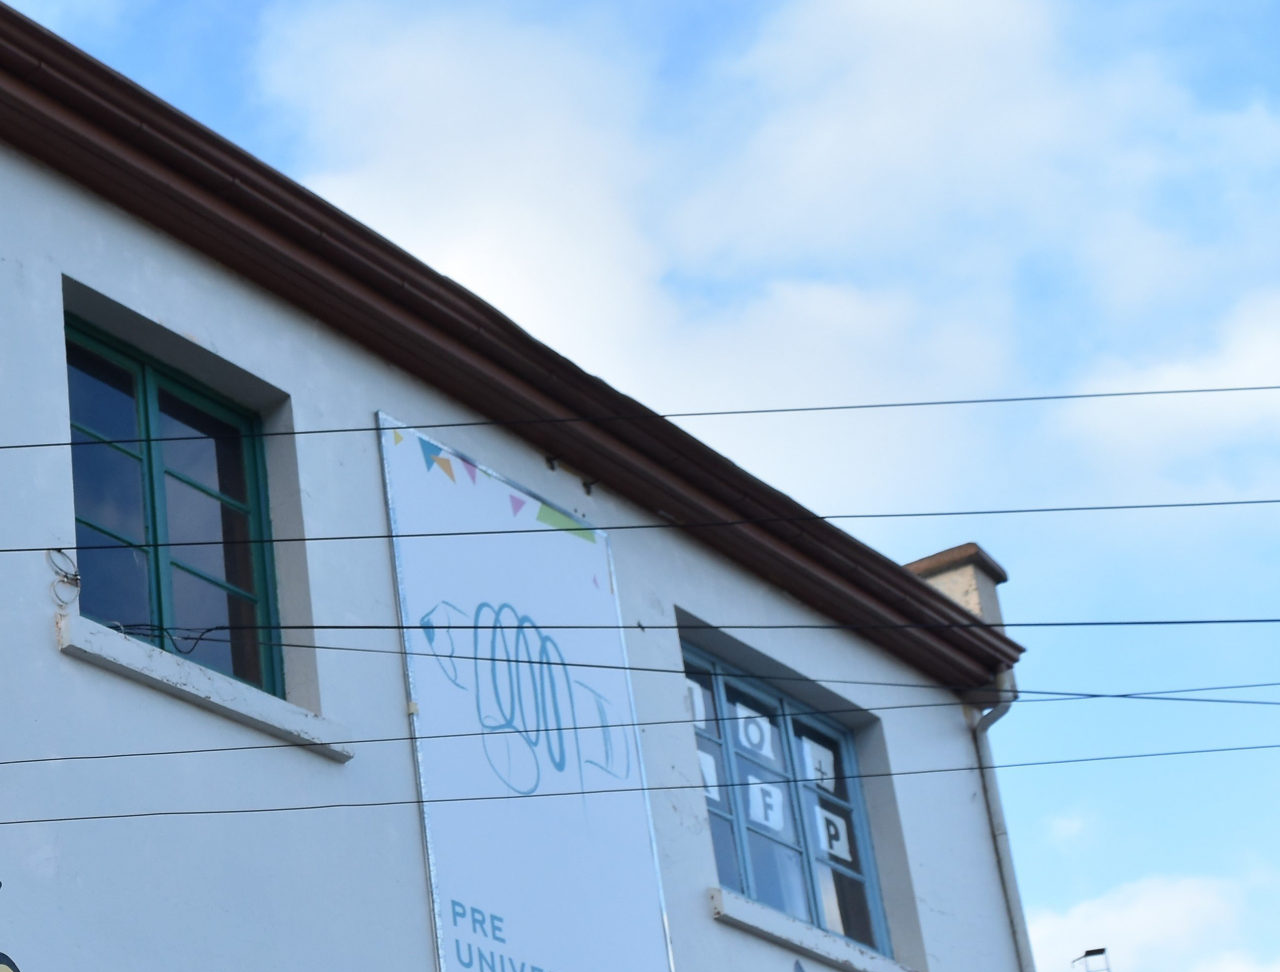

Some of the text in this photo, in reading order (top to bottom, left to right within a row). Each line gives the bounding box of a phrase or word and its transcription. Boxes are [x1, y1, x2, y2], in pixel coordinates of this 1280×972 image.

[761, 786, 775, 821] F
[824, 816, 841, 851] P
[451, 899, 507, 945] PRE
